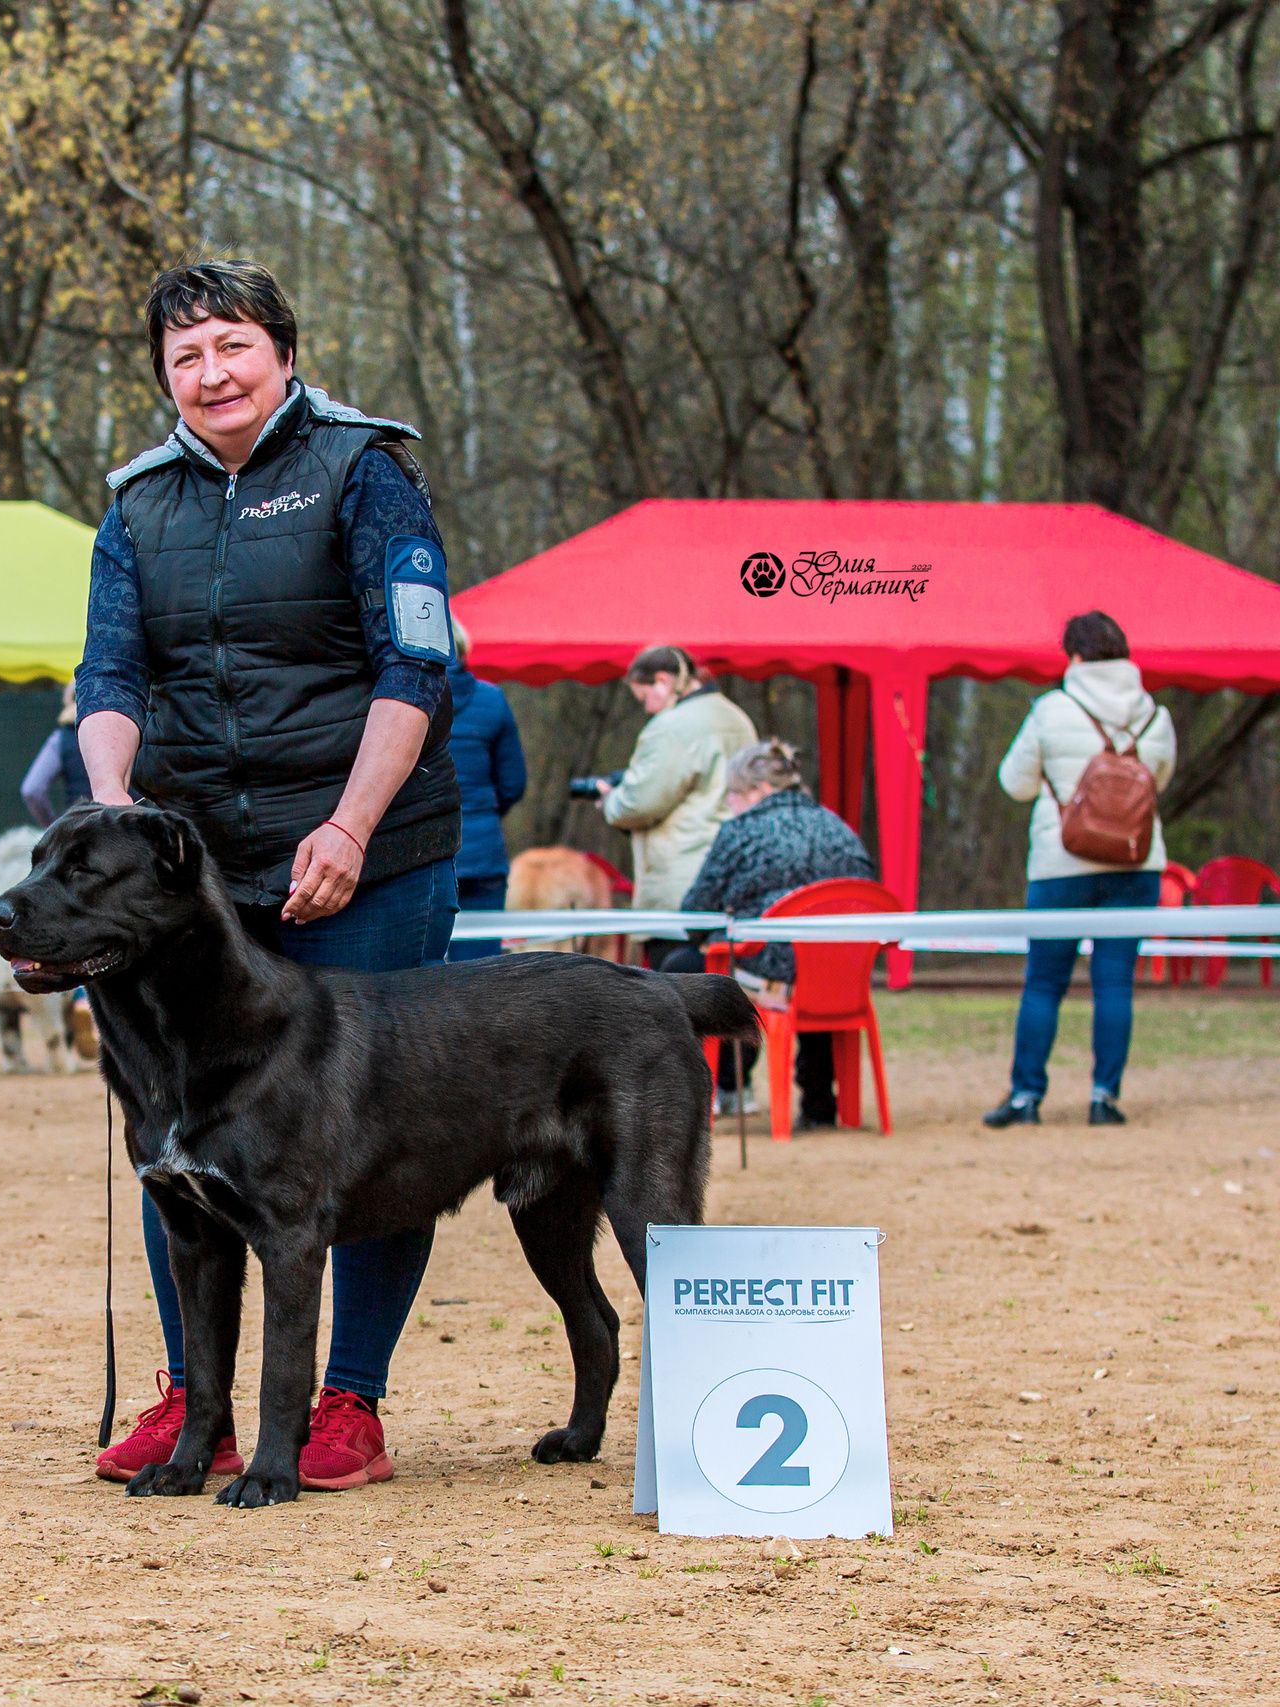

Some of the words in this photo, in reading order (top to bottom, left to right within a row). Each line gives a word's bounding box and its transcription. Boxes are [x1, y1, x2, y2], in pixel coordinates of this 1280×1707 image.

[416, 602, 434, 619] 5
[674, 1279, 803, 1306] PERFECT
[811, 1279, 854, 1306] FIT
[766, 1308, 773, 1316] О
[775, 1308, 815, 1316] ЗДОРОВЬЕ
[736, 1394, 810, 1486] 2
